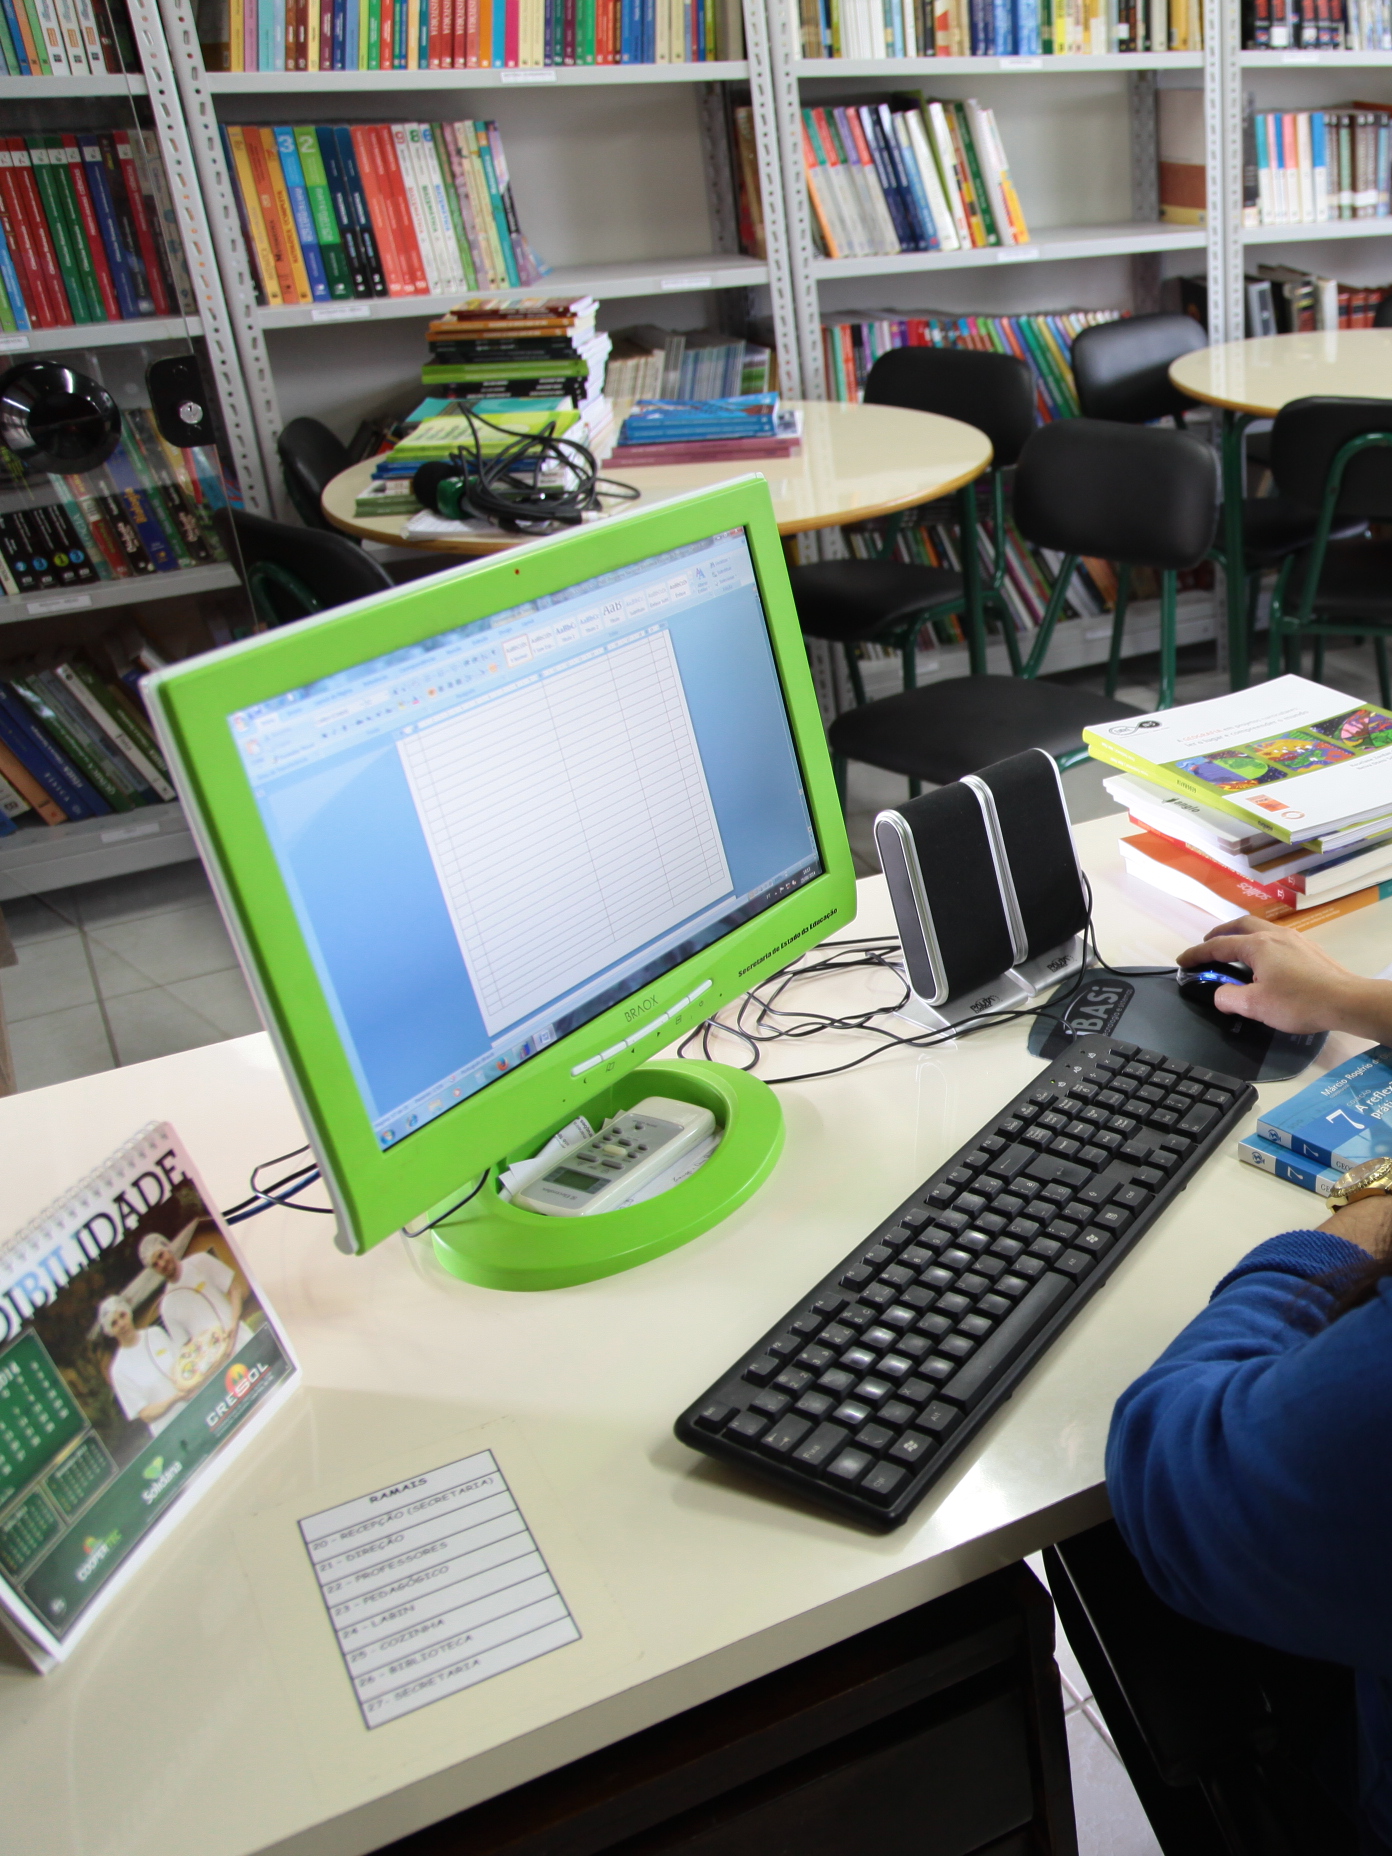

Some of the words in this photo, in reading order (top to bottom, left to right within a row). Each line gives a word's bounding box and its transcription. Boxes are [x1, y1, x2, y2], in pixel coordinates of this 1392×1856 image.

[277, 135, 295, 152] 3
[300, 135, 315, 153] 2
[410, 129, 420, 143] 8
[1173, 799, 1201, 814] anglo
[738, 952, 772, 978] Secretaria
[772, 944, 780, 956] de
[780, 932, 801, 949] Estado
[801, 926, 809, 937] da
[810, 907, 838, 931] Educação
[1321, 1078, 1348, 1097] Márcio
[1346, 1063, 1373, 1081] Rogério
[1325, 1109, 1365, 1130] 7
[1355, 1104, 1368, 1113] A
[1303, 1144, 1319, 1157] 7
[1287, 1166, 1304, 1180] 7
[1320, 1183, 1333, 1193] GE
[205, 1362, 269, 1428] CRESOL
[803, 1445, 820, 1459] Fixa
[369, 1477, 428, 1504] RAMAIS
[312, 1539, 328, 1551] 20
[339, 1510, 404, 1540] RECEPÇÃO
[407, 1477, 494, 1516] (SECRETARIA)
[319, 1561, 334, 1573] 21
[345, 1533, 405, 1562] DIREÇÃO
[326, 1582, 342, 1594] 22
[355, 1541, 449, 1583] PROFESSORES
[334, 1604, 350, 1617] 23
[362, 1565, 450, 1605] PEDAGÓGICO
[342, 1626, 359, 1640] 24
[350, 1650, 367, 1663] 25
[379, 1618, 445, 1650] COZINHA
[358, 1674, 376, 1688] 26
[388, 1634, 473, 1675] BIBLIOTECA
[393, 1659, 481, 1701] SECRETARIA
